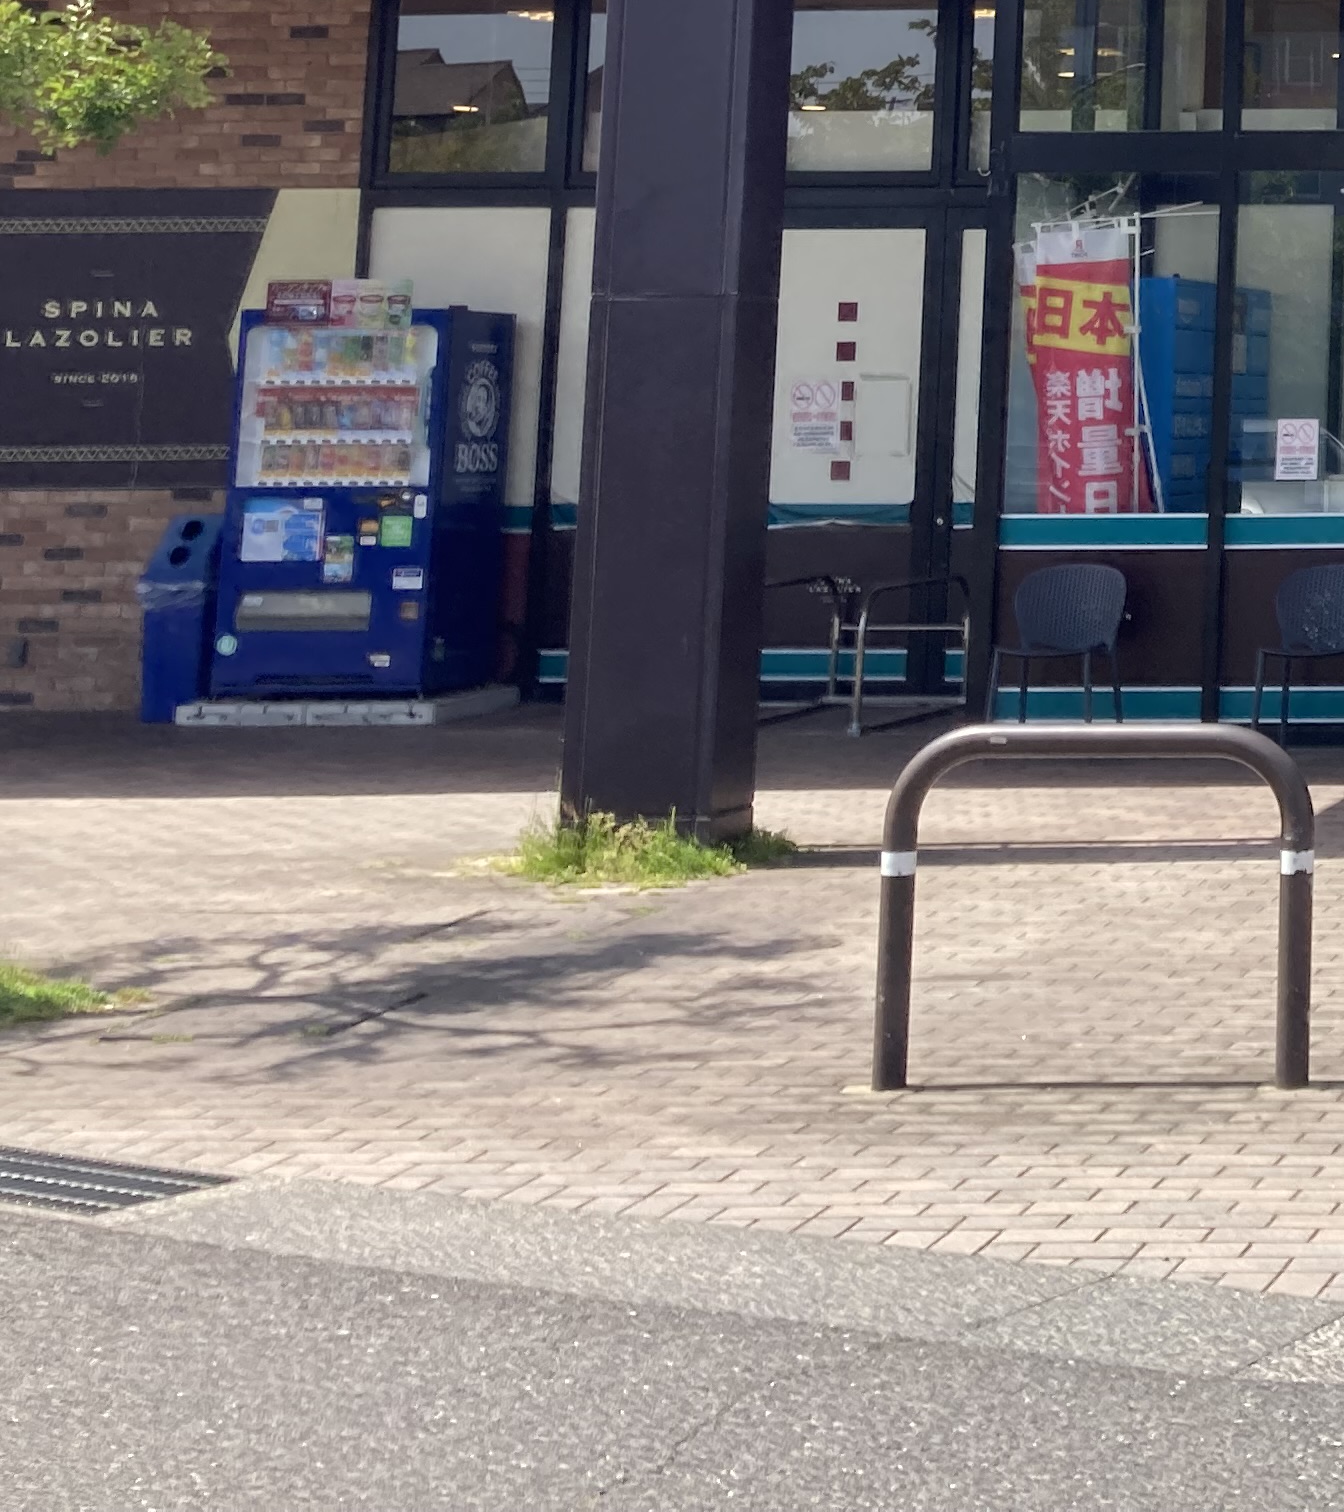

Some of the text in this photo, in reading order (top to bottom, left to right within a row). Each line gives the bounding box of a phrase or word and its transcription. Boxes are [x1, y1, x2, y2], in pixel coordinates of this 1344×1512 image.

[44, 299, 159, 319] SPINA
[5, 327, 193, 348] LAZOLIER
[455, 443, 499, 473] BOSS
